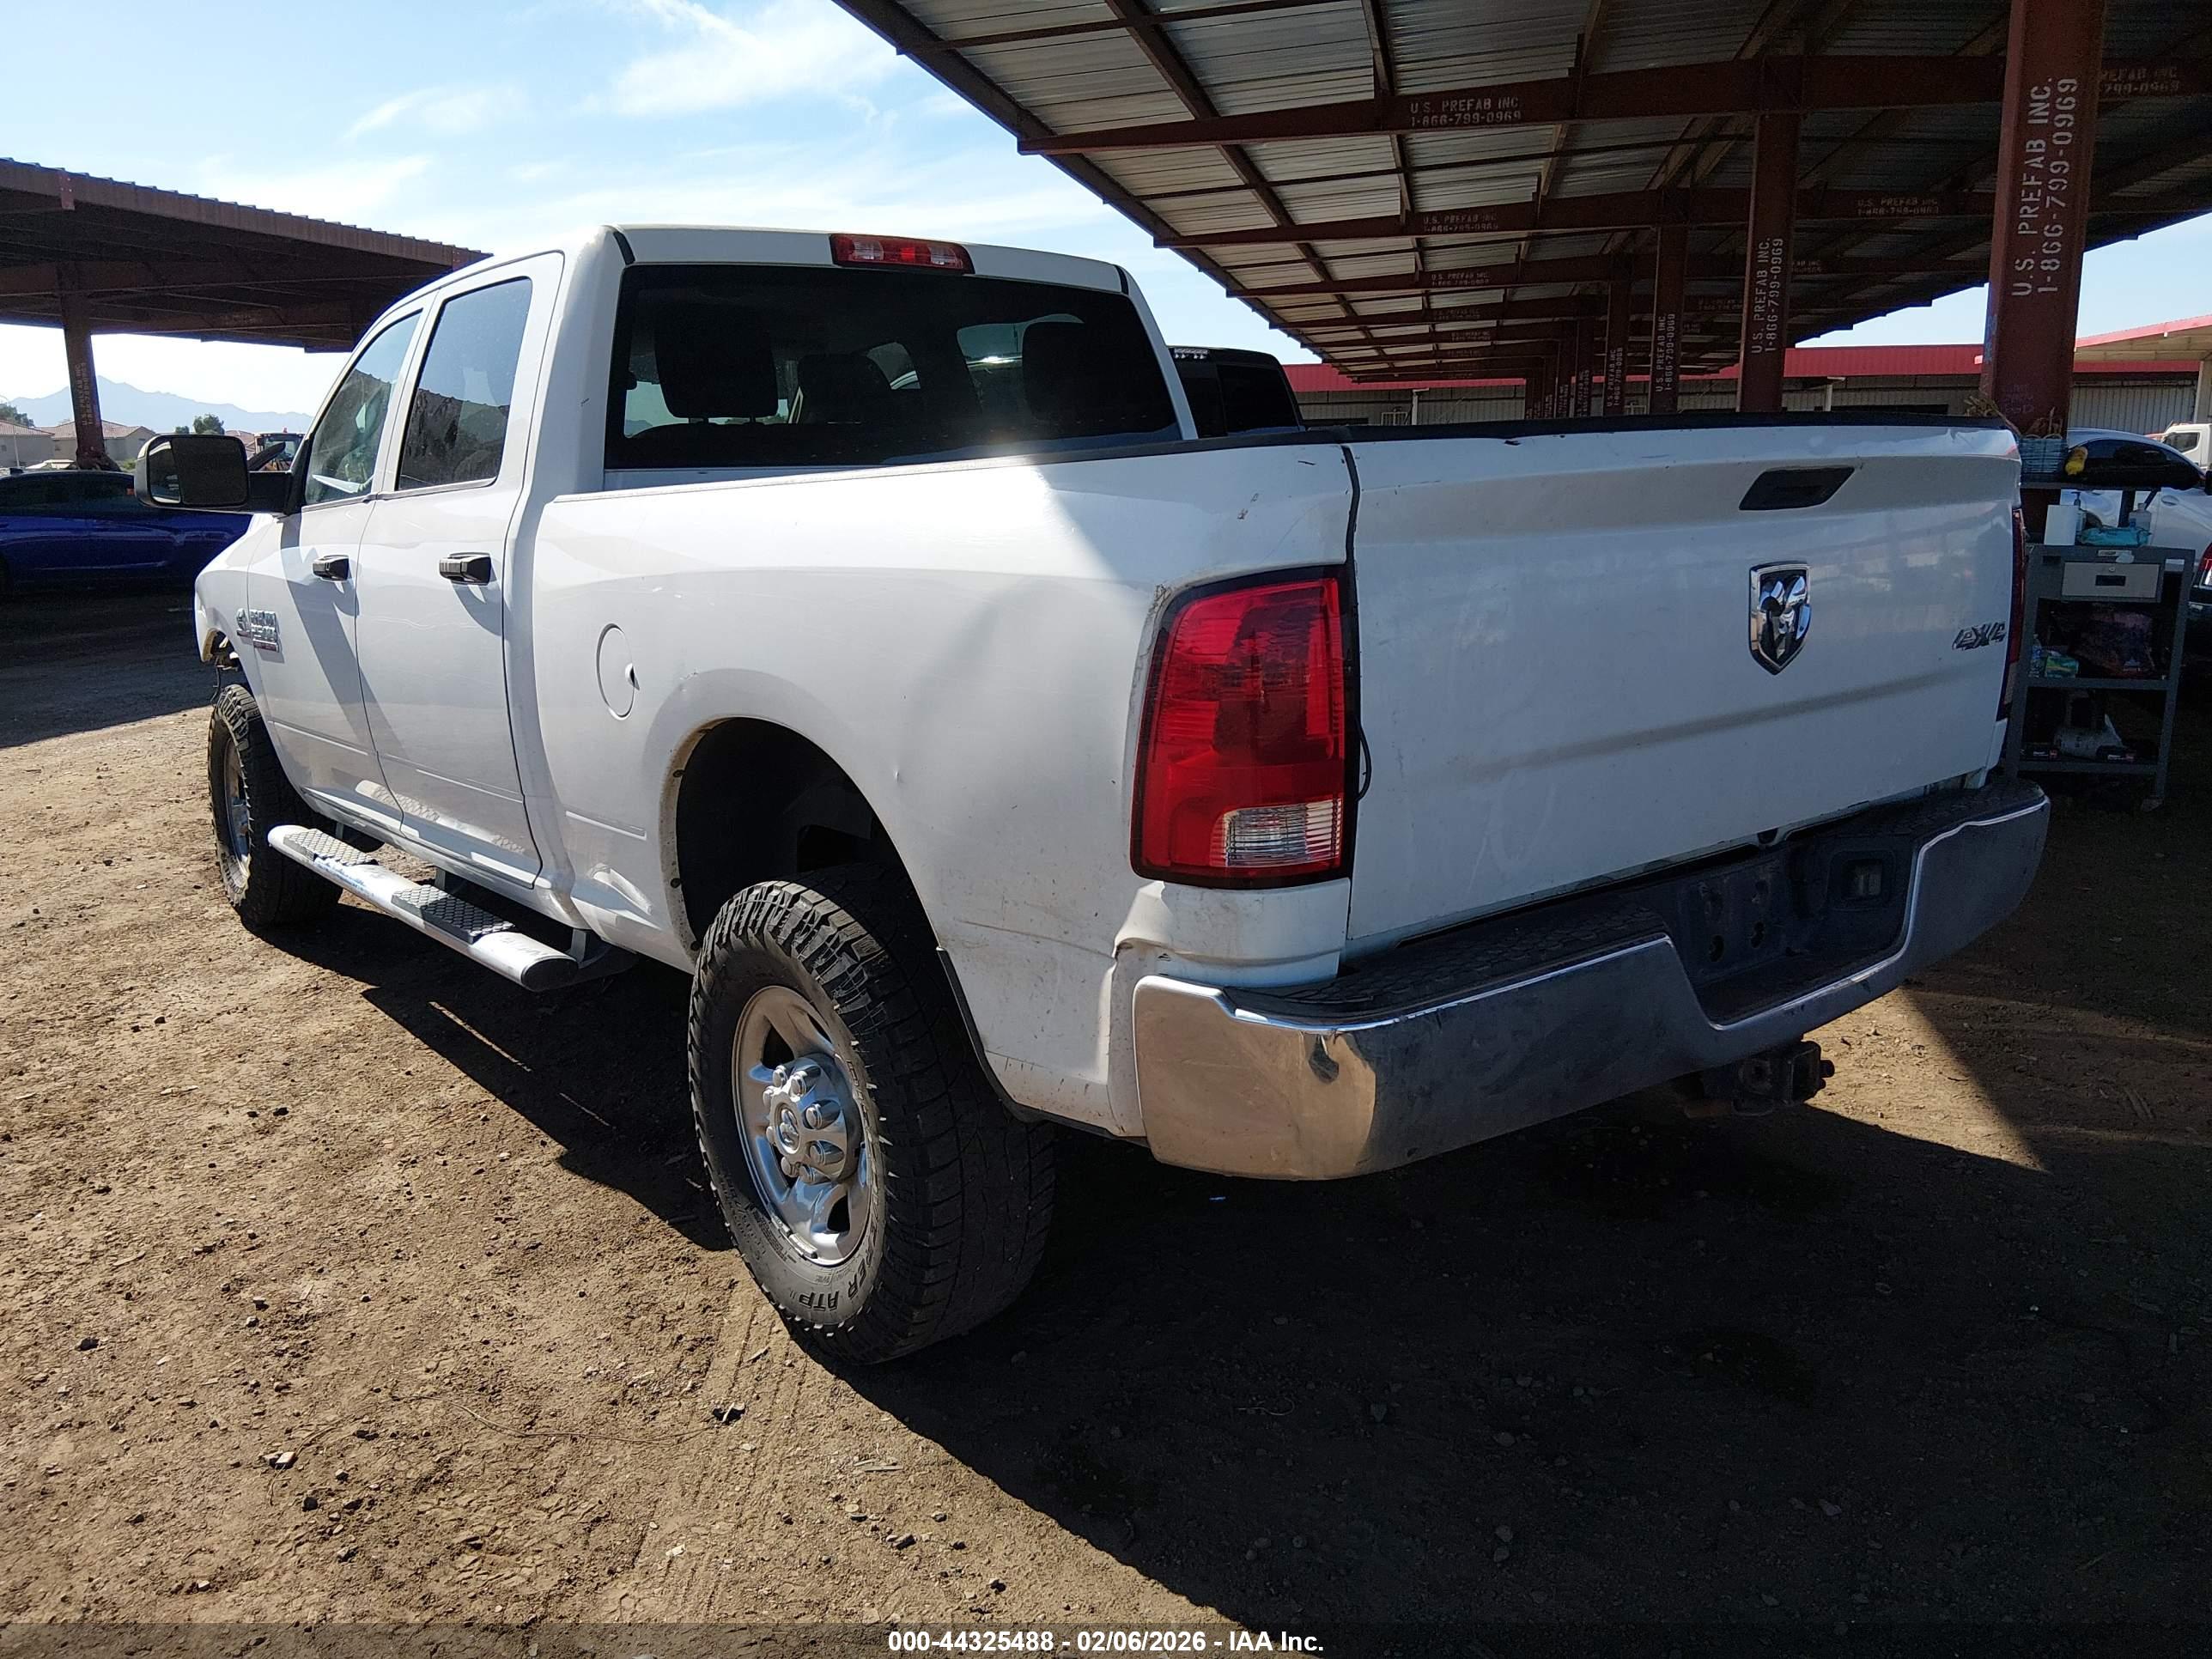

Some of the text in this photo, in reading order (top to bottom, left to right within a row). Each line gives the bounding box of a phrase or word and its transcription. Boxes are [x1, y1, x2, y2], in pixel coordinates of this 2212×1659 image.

[1410, 110, 1522, 127] 1-866-799-0969
[1442, 98, 1492, 112] PREFAB
[2011, 77, 2052, 295] U.S. PREFAB INC.
[2037, 78, 2078, 293] 1-866-799-0969
[1753, 270, 1768, 320] PREFAB
[1765, 238, 1784, 351] 1-866-799-0969
[1751, 328, 1765, 353] U.S.
[799, 1290, 840, 1311] ATP
